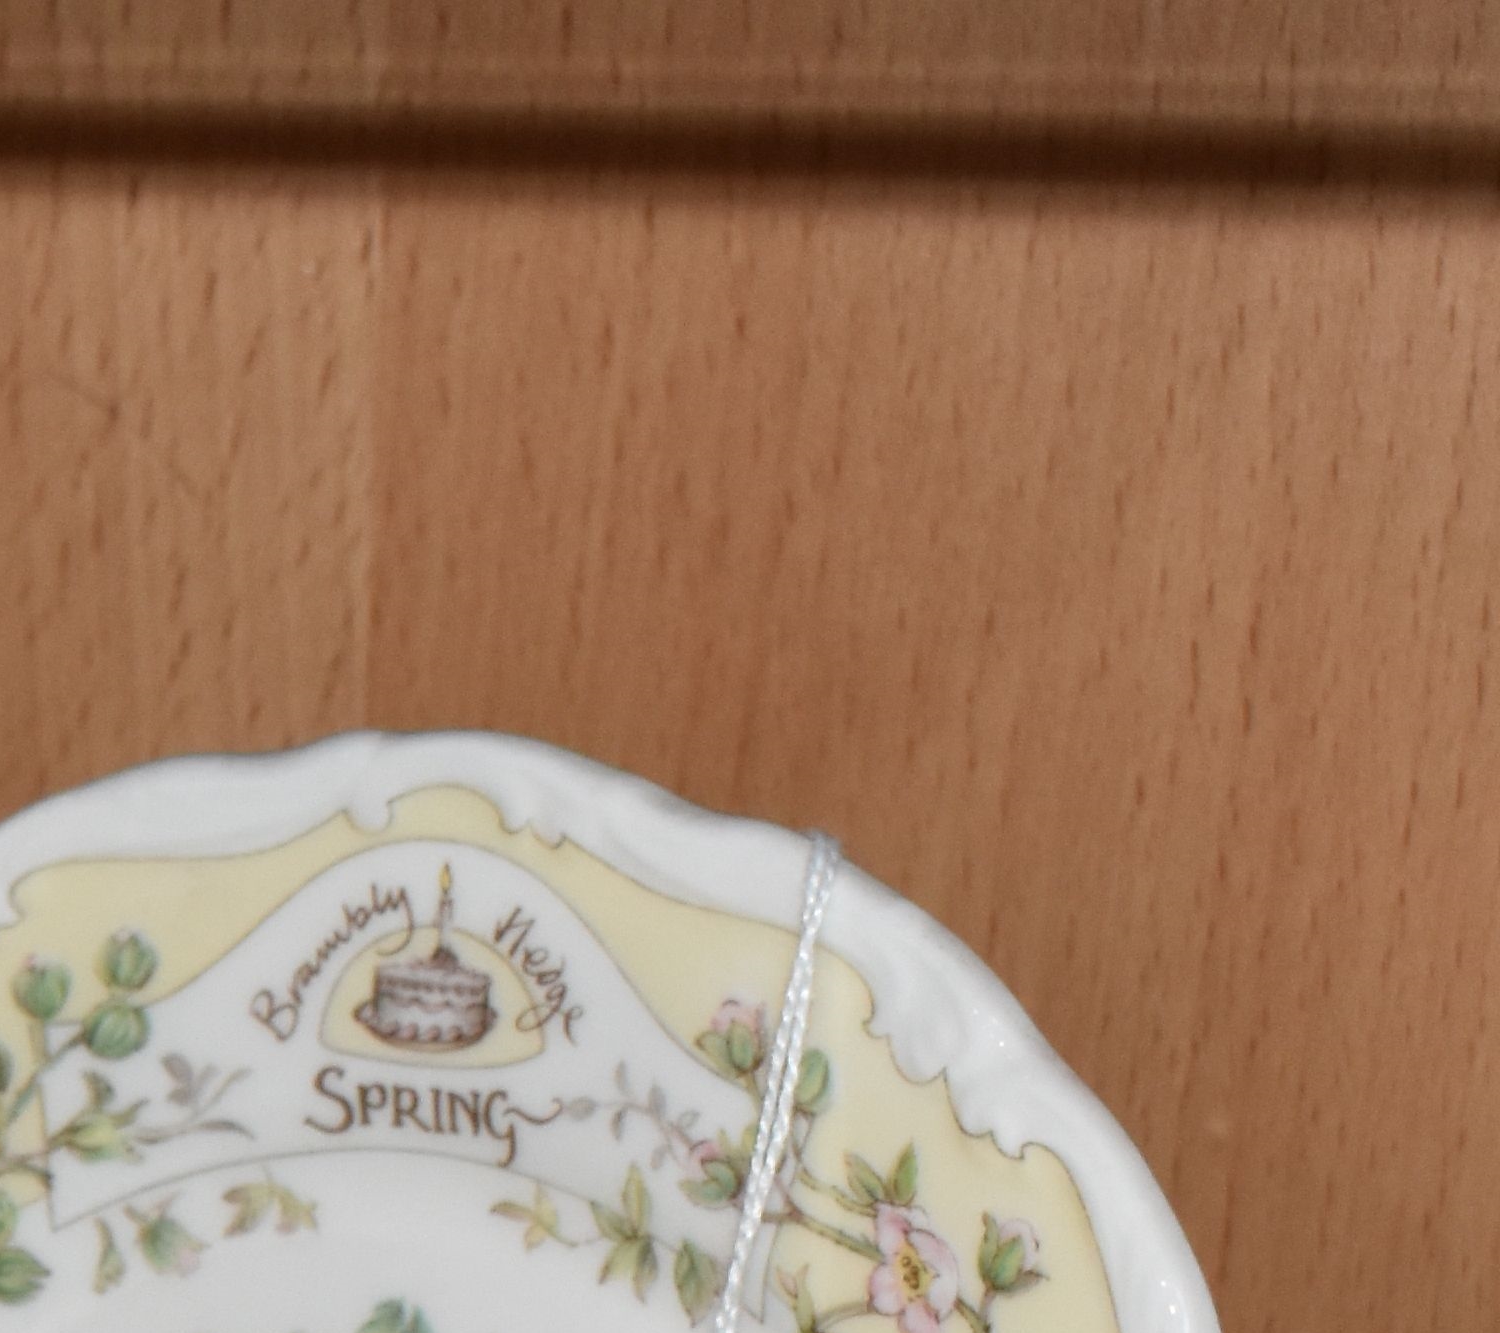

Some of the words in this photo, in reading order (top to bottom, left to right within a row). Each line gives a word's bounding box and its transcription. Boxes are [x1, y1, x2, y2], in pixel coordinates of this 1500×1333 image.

[250, 883, 415, 1043] Brambly
[494, 906, 585, 1047] Hedge
[305, 1064, 564, 1169] SPRING
